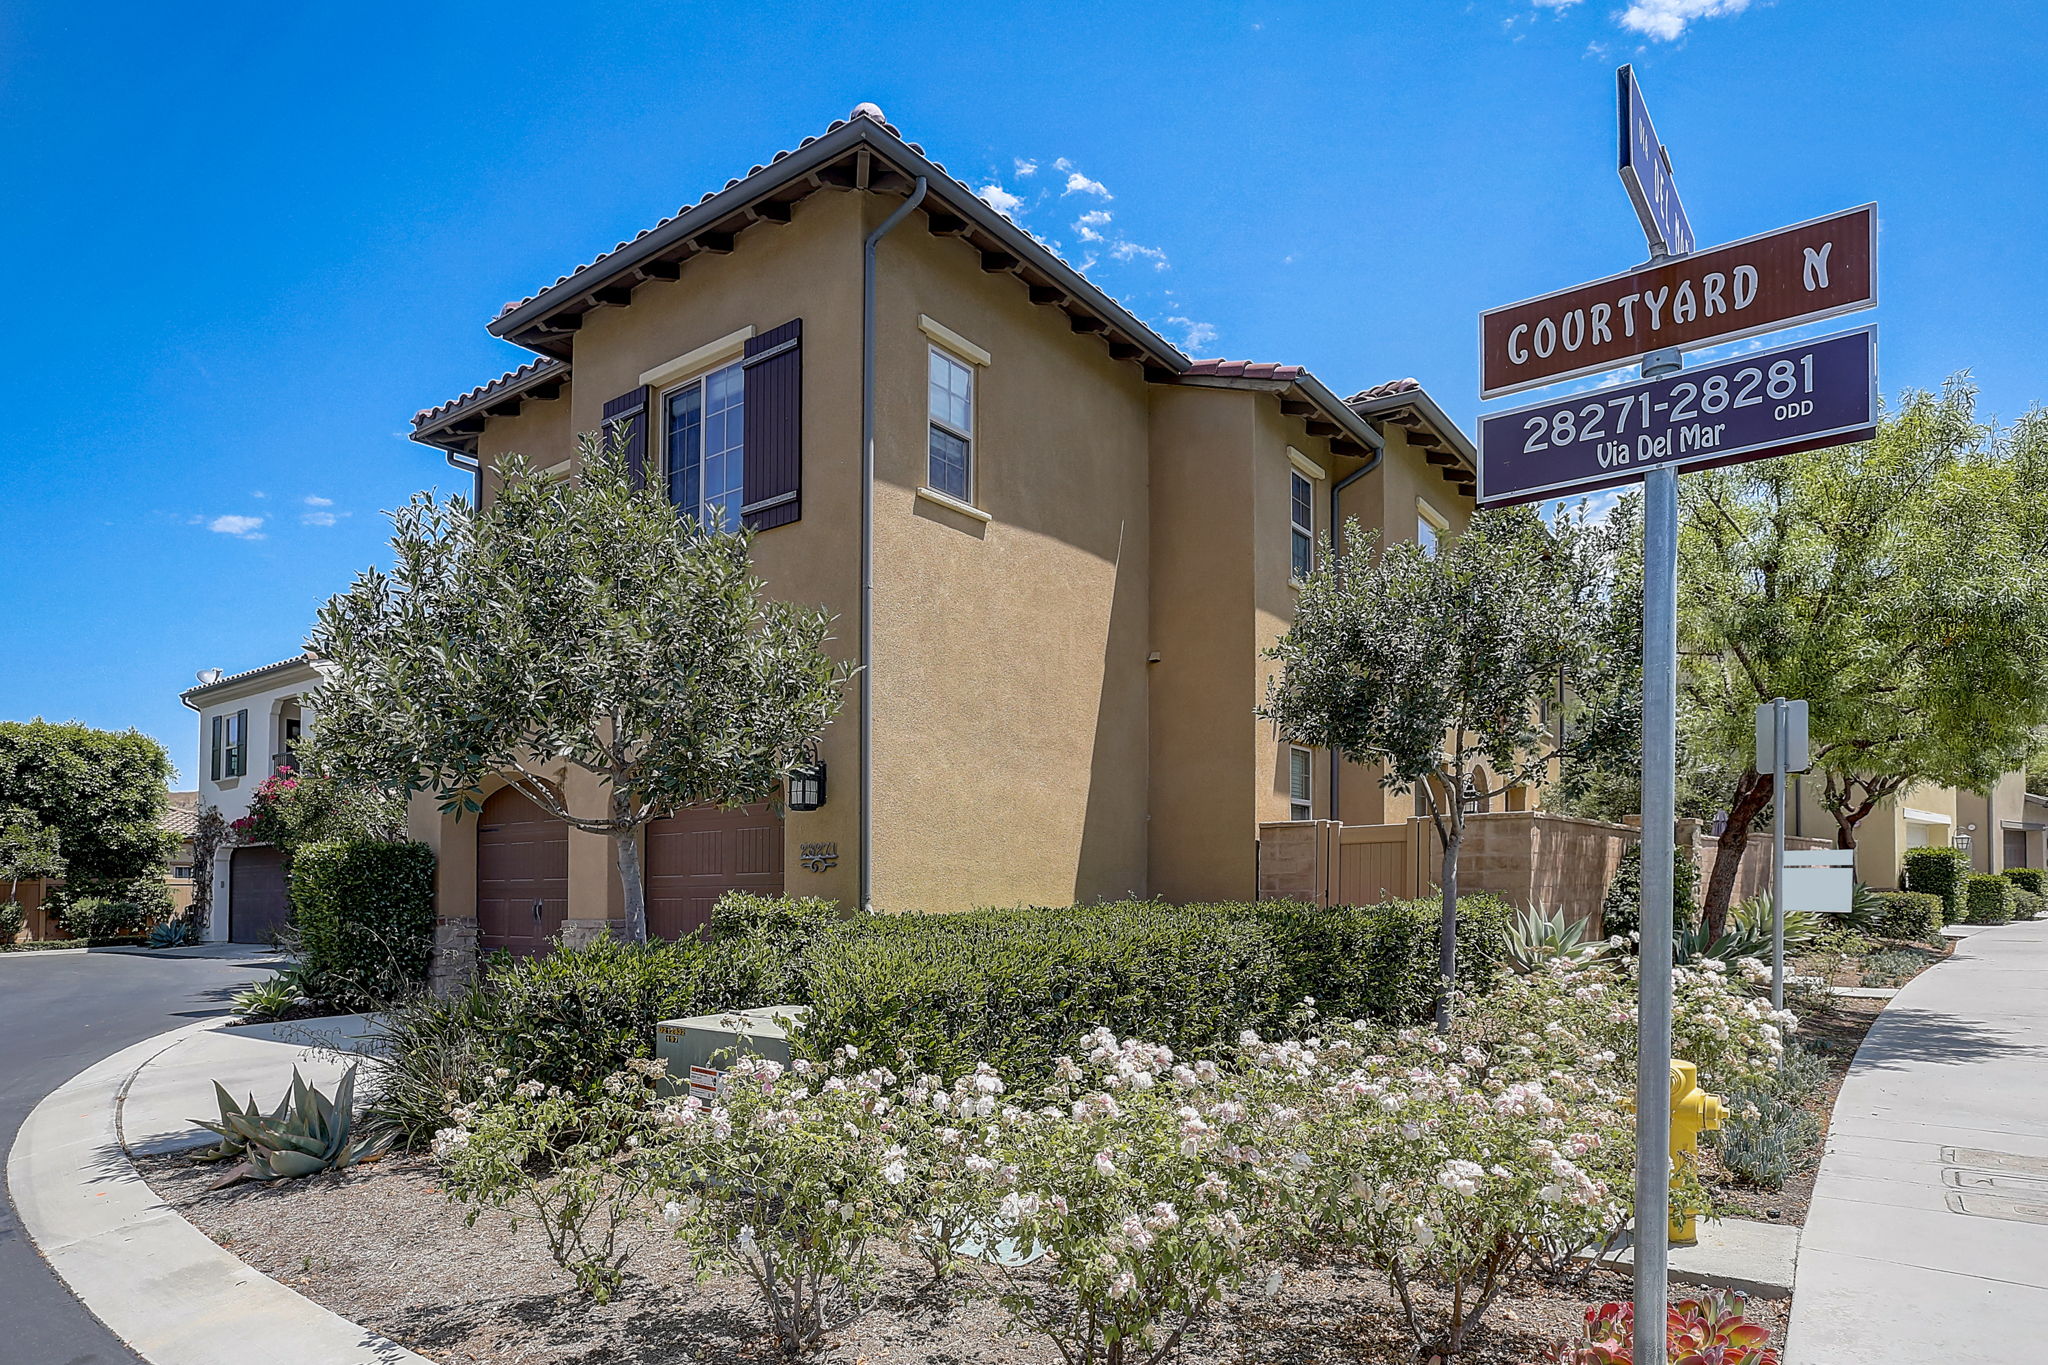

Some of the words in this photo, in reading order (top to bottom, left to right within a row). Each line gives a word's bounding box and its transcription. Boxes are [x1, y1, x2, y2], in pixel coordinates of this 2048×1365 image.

[1507, 264, 1760, 366] COURTYARD
[1803, 242, 1833, 292] N
[1523, 353, 1814, 456] 28271-28281
[1774, 400, 1814, 422] ODD
[1597, 437, 1631, 470] Via
[1637, 427, 1673, 461] Del
[1680, 422, 1726, 453] Mar
